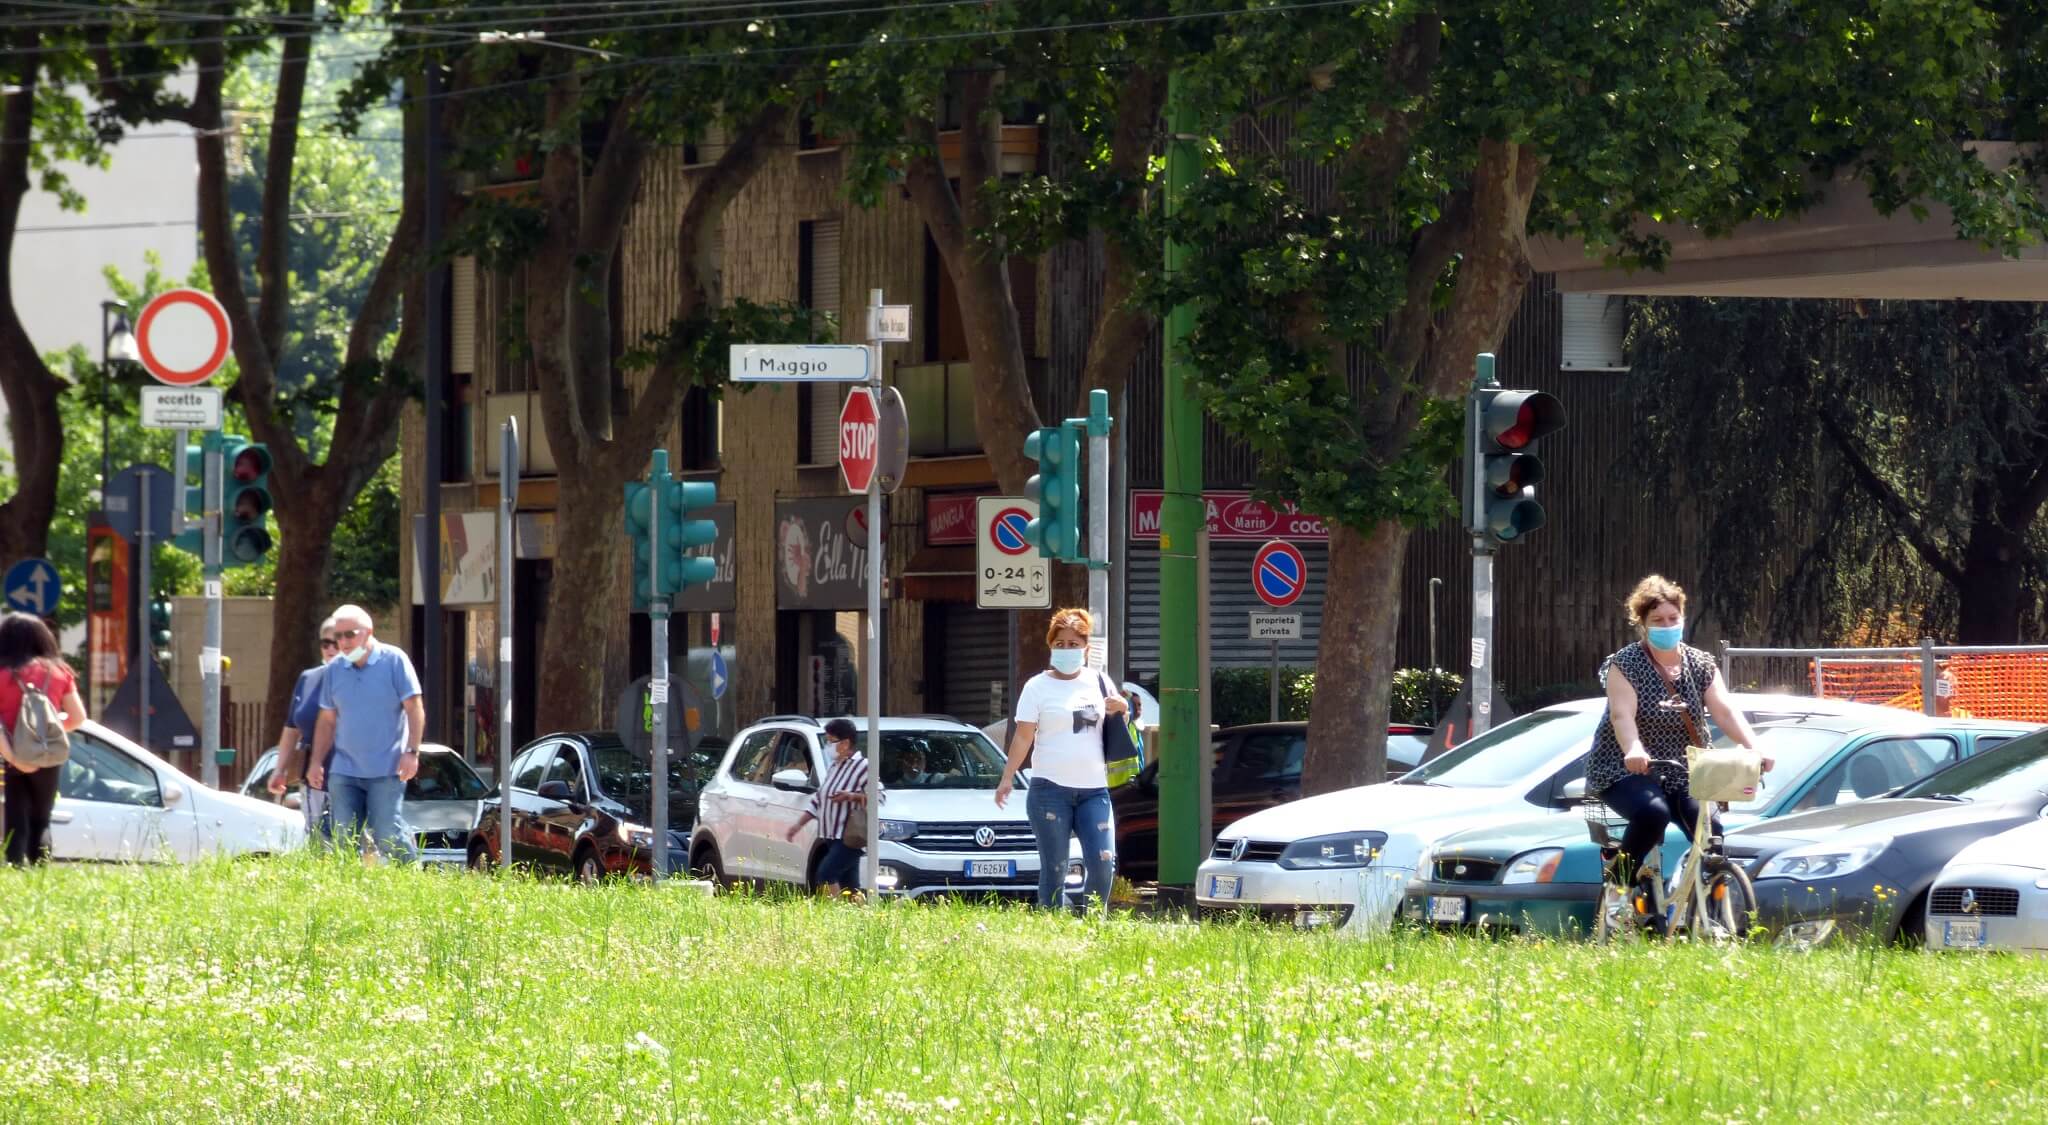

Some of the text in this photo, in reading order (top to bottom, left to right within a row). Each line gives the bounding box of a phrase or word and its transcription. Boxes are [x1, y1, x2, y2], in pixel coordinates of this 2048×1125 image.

[759, 358, 828, 376] Maggio
[157, 394, 203, 406] eccetto
[842, 421, 876, 460] STOP
[1235, 516, 1266, 529] Marin
[814, 520, 847, 585] Ella
[208, 584, 217, 596] L
[1260, 627, 1290, 635] privata
